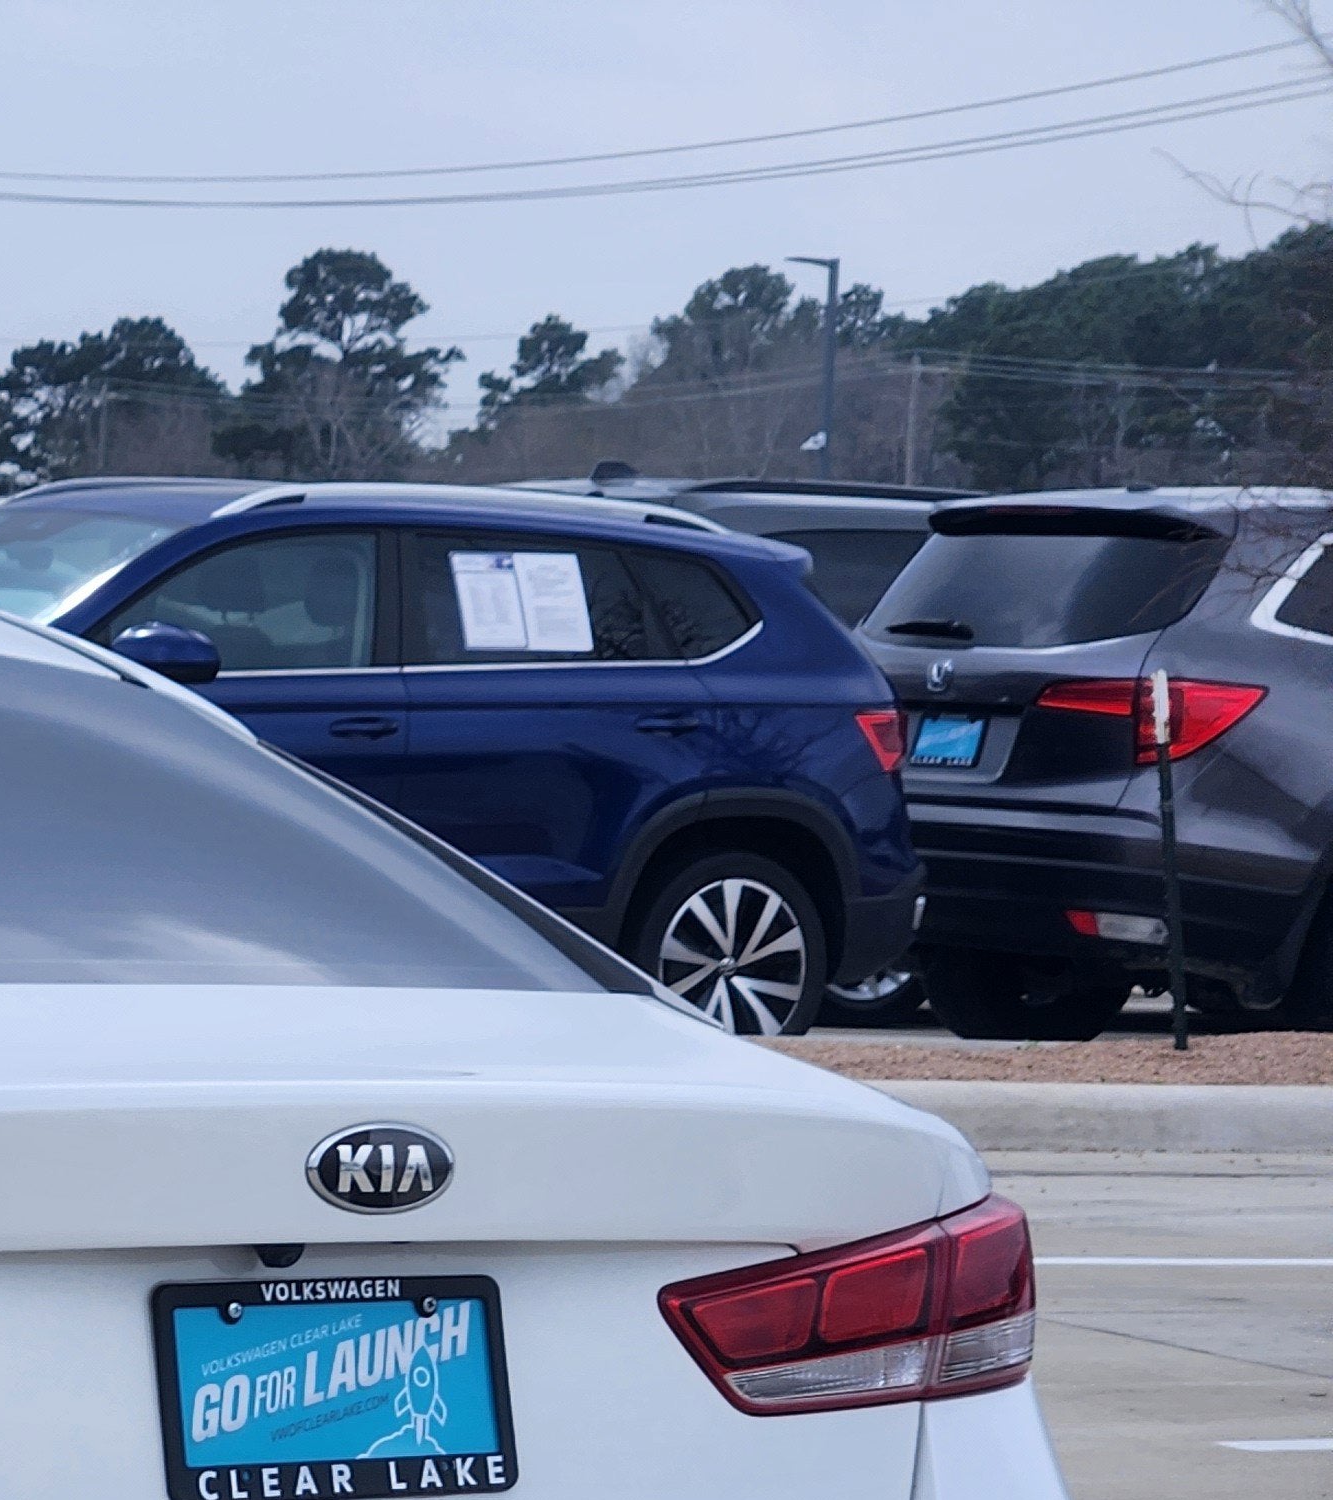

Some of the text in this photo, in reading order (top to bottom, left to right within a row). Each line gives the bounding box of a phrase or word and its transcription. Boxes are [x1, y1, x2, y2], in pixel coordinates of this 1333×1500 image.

[336, 1144, 434, 1193] KIA
[260, 1279, 400, 1302] VOLKSWAGEN
[201, 1314, 362, 1376] VOLKSWAGEN CLEAR LAKE
[191, 1301, 472, 1443] GO FOR LAUNCH
[198, 1454, 506, 1500] CLEAR LAKE
